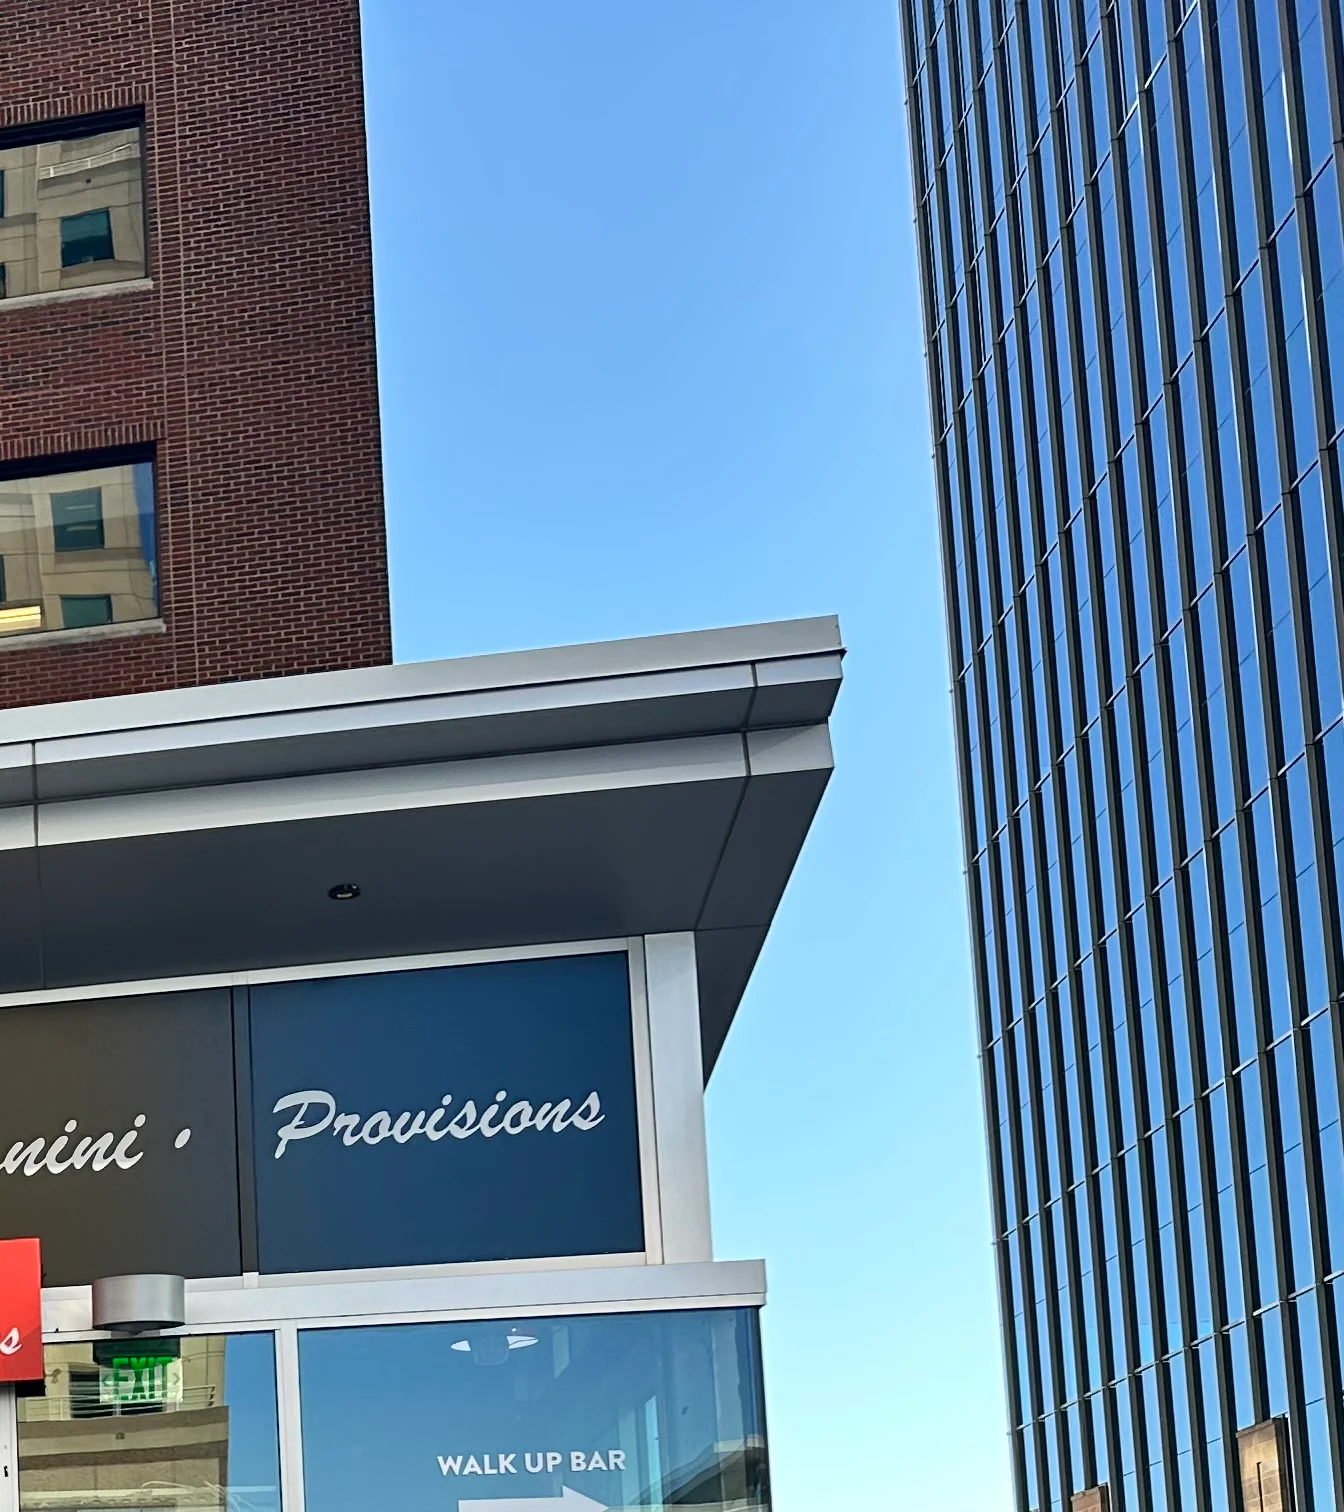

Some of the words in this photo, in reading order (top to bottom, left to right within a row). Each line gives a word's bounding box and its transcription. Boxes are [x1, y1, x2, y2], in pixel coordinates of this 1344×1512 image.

[272, 1089, 606, 1159] Provisions
[113, 1357, 173, 1400] EXIT
[437, 1453, 518, 1476] WALK
[524, 1452, 562, 1473] UP
[570, 1450, 626, 1472] BAR
